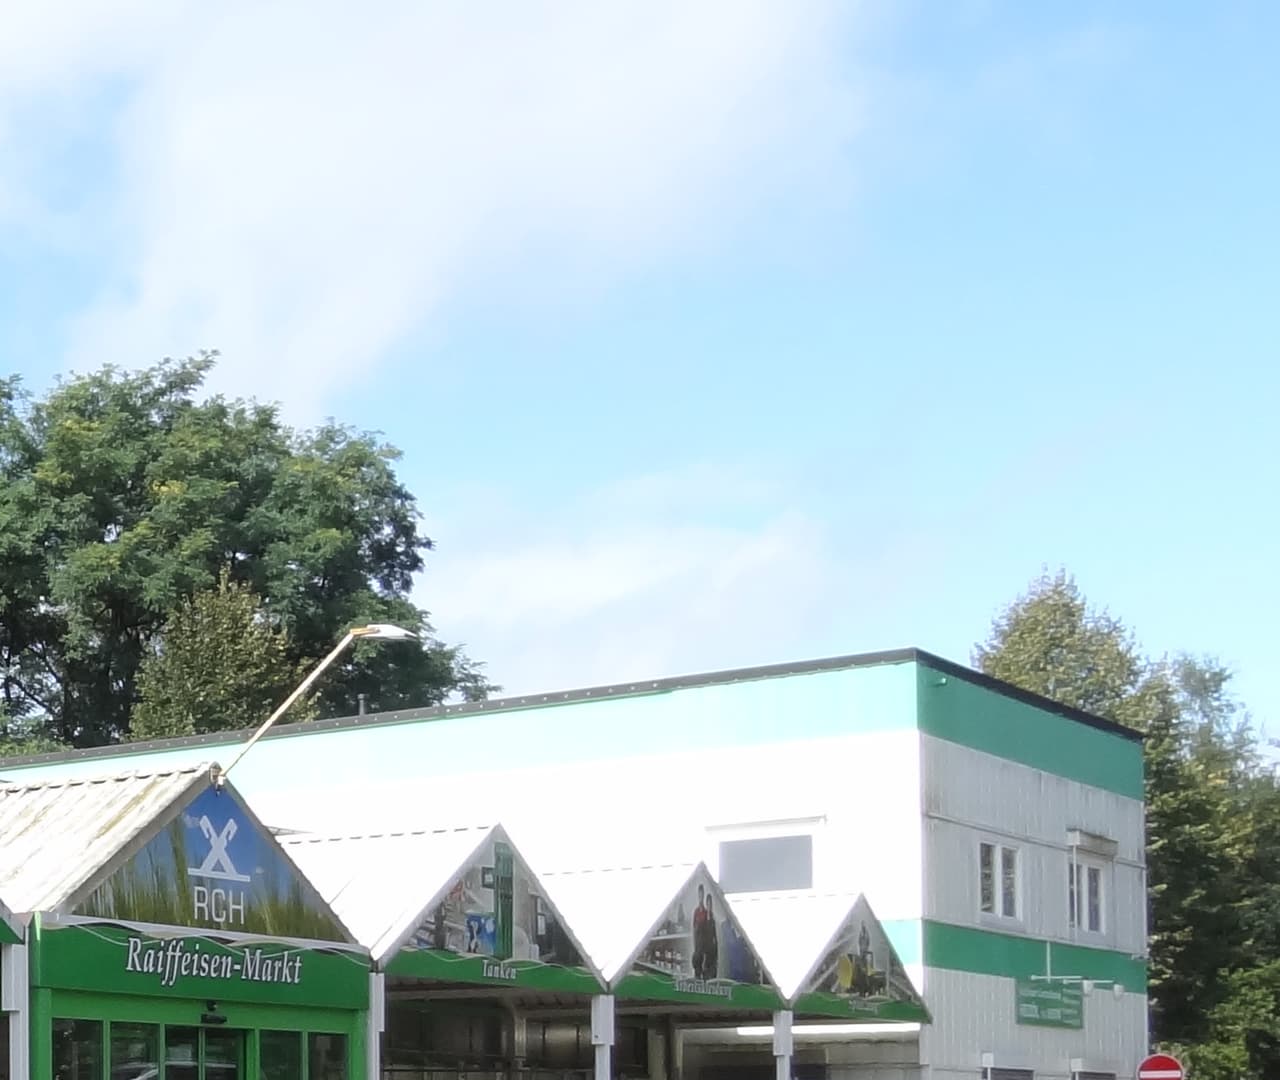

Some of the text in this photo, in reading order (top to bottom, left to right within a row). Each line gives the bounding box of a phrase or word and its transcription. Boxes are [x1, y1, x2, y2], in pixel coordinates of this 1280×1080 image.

[194, 886, 245, 925] RCH
[126, 938, 302, 986] Raiffeisen-Markt
[483, 960, 517, 979] Tanken
